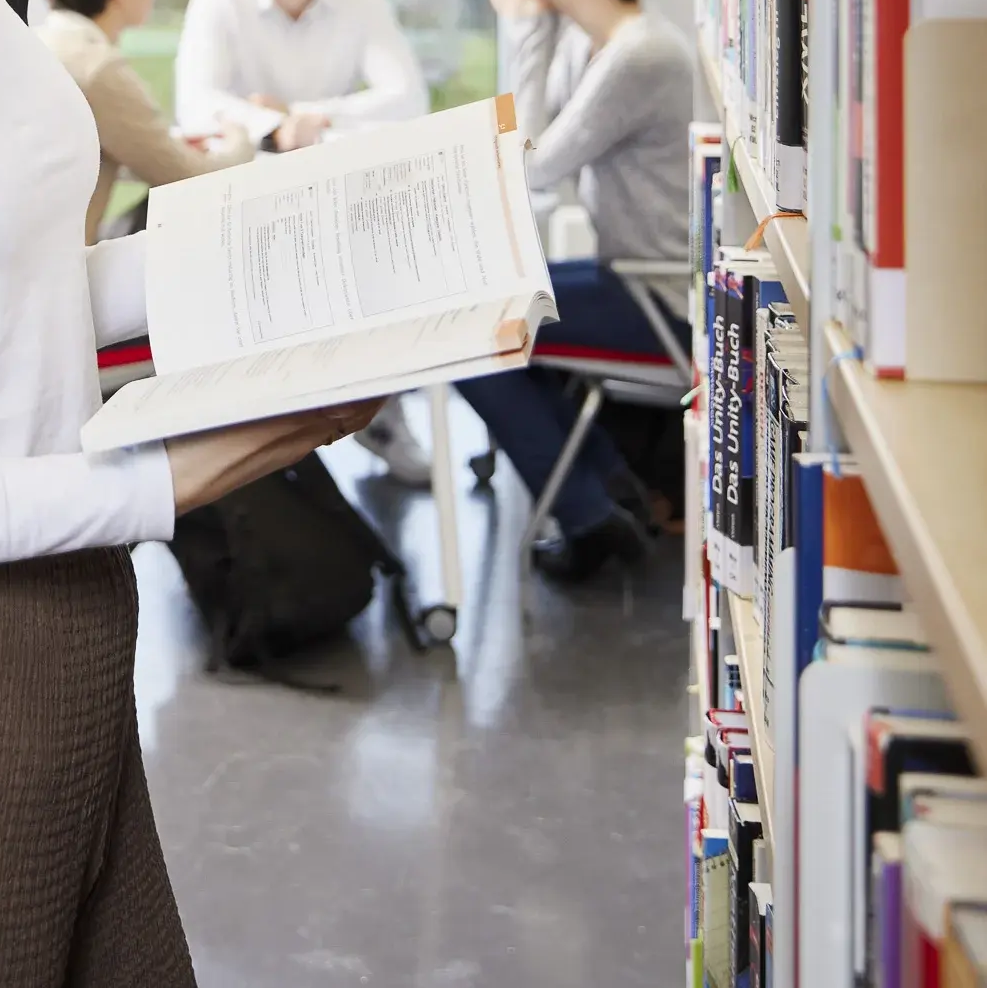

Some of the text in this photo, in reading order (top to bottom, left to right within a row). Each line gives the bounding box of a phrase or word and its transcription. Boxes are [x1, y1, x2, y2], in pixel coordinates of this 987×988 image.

[712, 315, 726, 496] Das Unity-Buch
[726, 323, 742, 506] Das Unity-Buch
